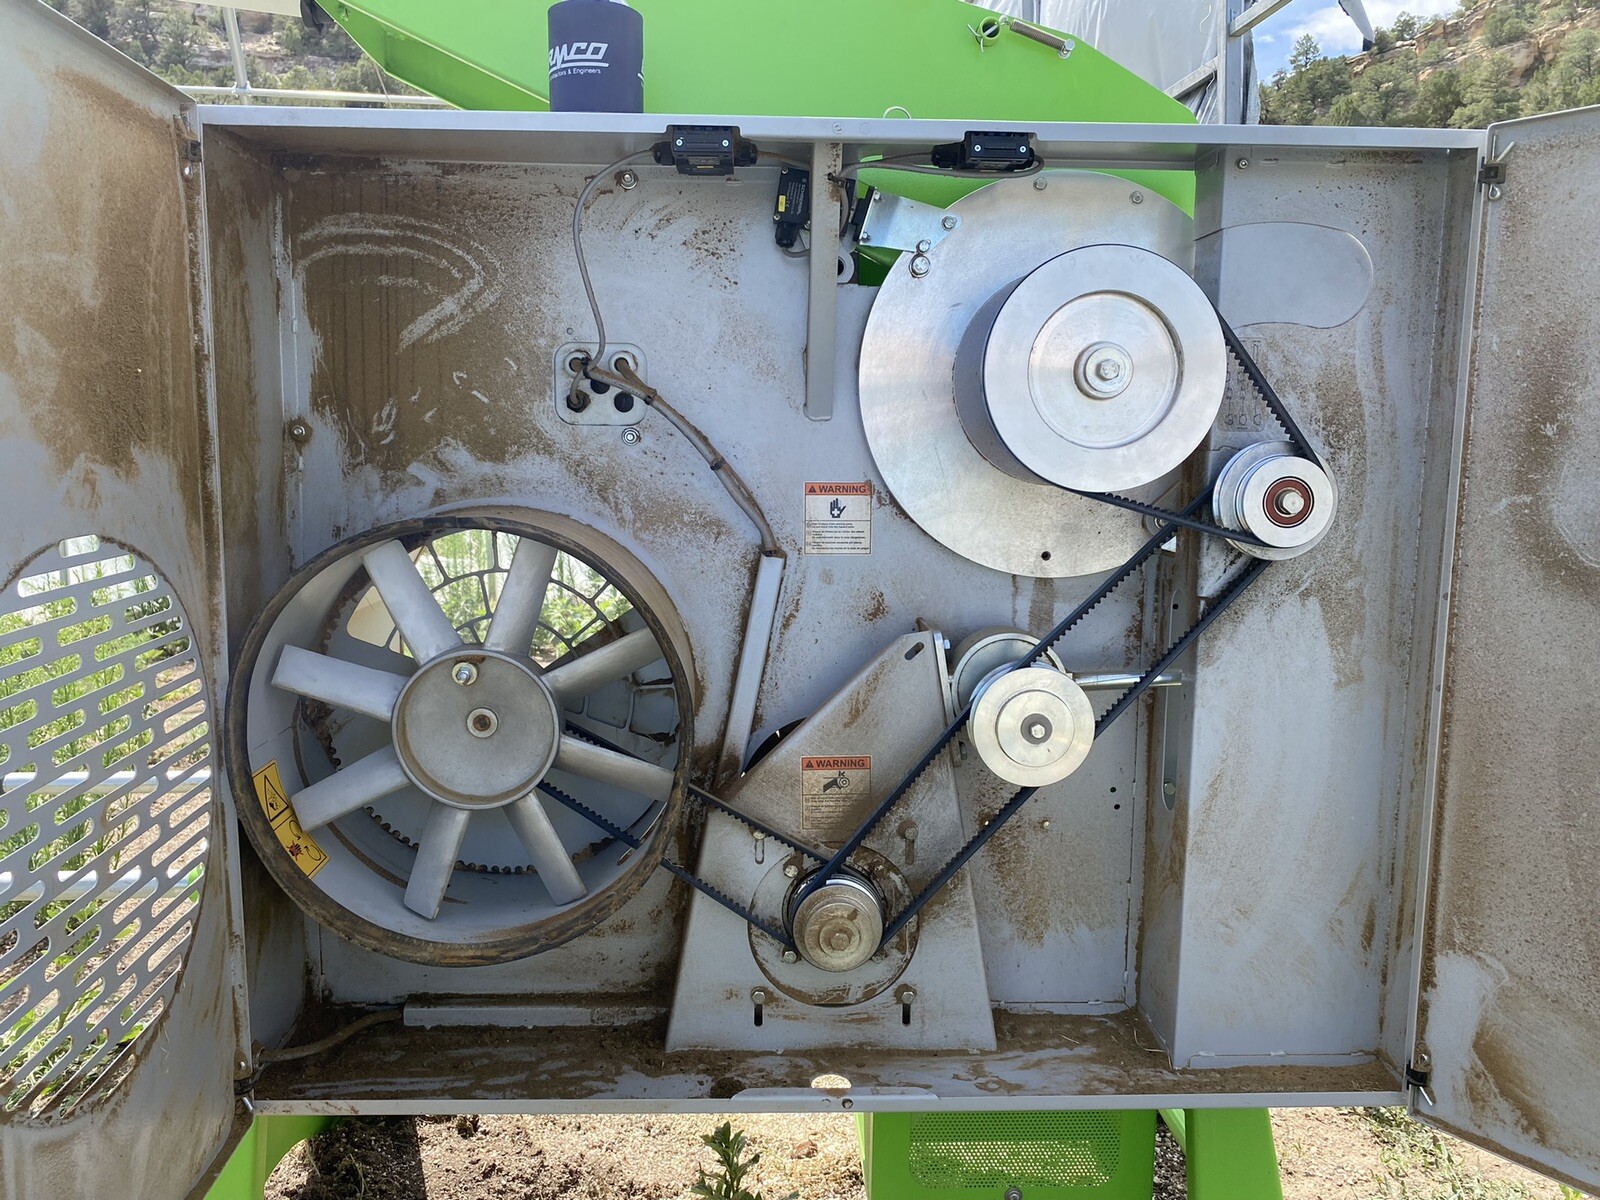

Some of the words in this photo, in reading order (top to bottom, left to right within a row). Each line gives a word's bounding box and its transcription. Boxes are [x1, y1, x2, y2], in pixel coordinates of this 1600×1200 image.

[573, 67, 602, 75] Engineers
[818, 485, 867, 494] WARNING
[815, 759, 865, 768] WARNING
